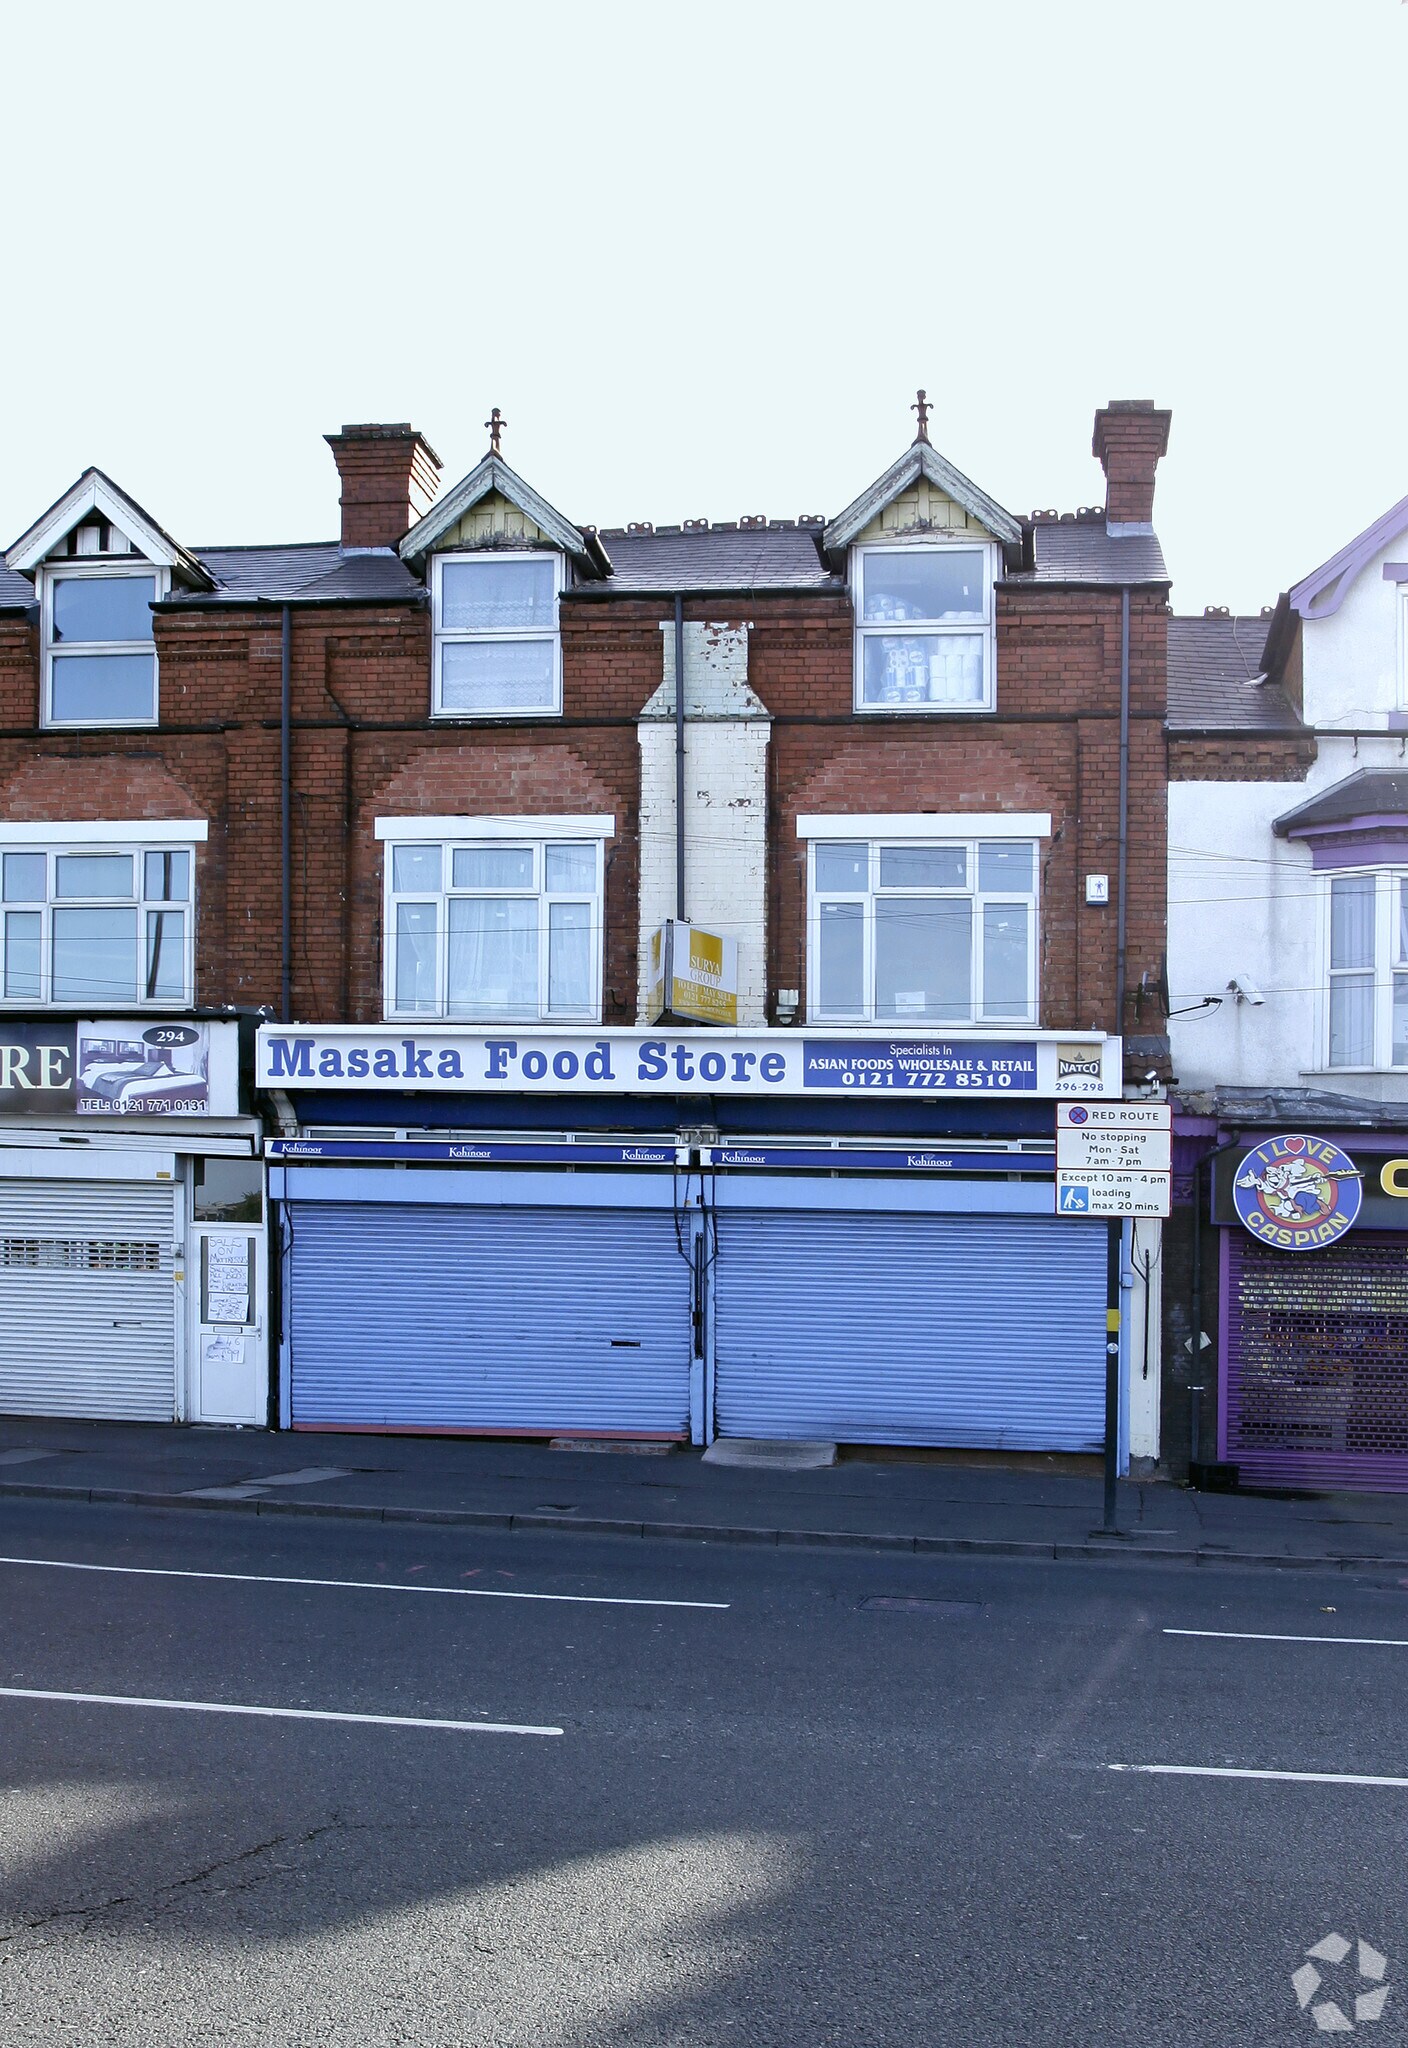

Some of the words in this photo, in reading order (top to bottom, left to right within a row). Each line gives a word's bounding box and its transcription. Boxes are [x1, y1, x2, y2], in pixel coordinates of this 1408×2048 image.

[690, 955, 721, 975] SURYA
[690, 969, 721, 987] GROUP
[703, 986, 716, 998] MAY
[717, 990, 732, 1002] SELL
[156, 1031, 185, 1042] 294
[889, 1044, 940, 1057] Specialists
[943, 1045, 952, 1056] In
[267, 1039, 464, 1079] Masaka
[484, 1041, 615, 1080] Food
[637, 1042, 787, 1082] Store
[808, 1059, 846, 1070] ASIAN
[851, 1059, 893, 1070] FOODS
[898, 1059, 973, 1072] WHOLESALE
[977, 1060, 988, 1072] &
[991, 1060, 1034, 1072] RETAIL
[1060, 1061, 1099, 1074] NATCO
[842, 1072, 894, 1085] 0121
[905, 1073, 946, 1086] 772
[955, 1073, 1011, 1087] 8510
[1055, 1083, 1104, 1091] 296-298
[81, 1099, 110, 1110] TEL:
[113, 1100, 143, 1110] 0121
[148, 1100, 170, 1111] 771
[175, 1101, 206, 1111] 0131
[1092, 1111, 1115, 1120] RED
[1120, 1112, 1159, 1120] ROUTE
[1082, 1132, 1096, 1141] No
[1101, 1133, 1147, 1143] stopping
[281, 1143, 322, 1154] Kohinoor
[449, 1146, 491, 1158] Kohinoor
[1089, 1145, 1112, 1154] Mon
[1120, 1146, 1139, 1154] Sat
[622, 1149, 665, 1161] Kohinoor
[721, 1152, 765, 1164] Kohinoor
[907, 1155, 952, 1167] Kohinoor
[1256, 1150, 1269, 1163] I
[1061, 1173, 1098, 1183] Except
[1092, 1188, 1131, 1198] loading
[1117, 1202, 1132, 1210] 20
[1135, 1202, 1159, 1211] mins
[1247, 1212, 1349, 1245] CASPIAN
[218, 1246, 233, 1255] ON
